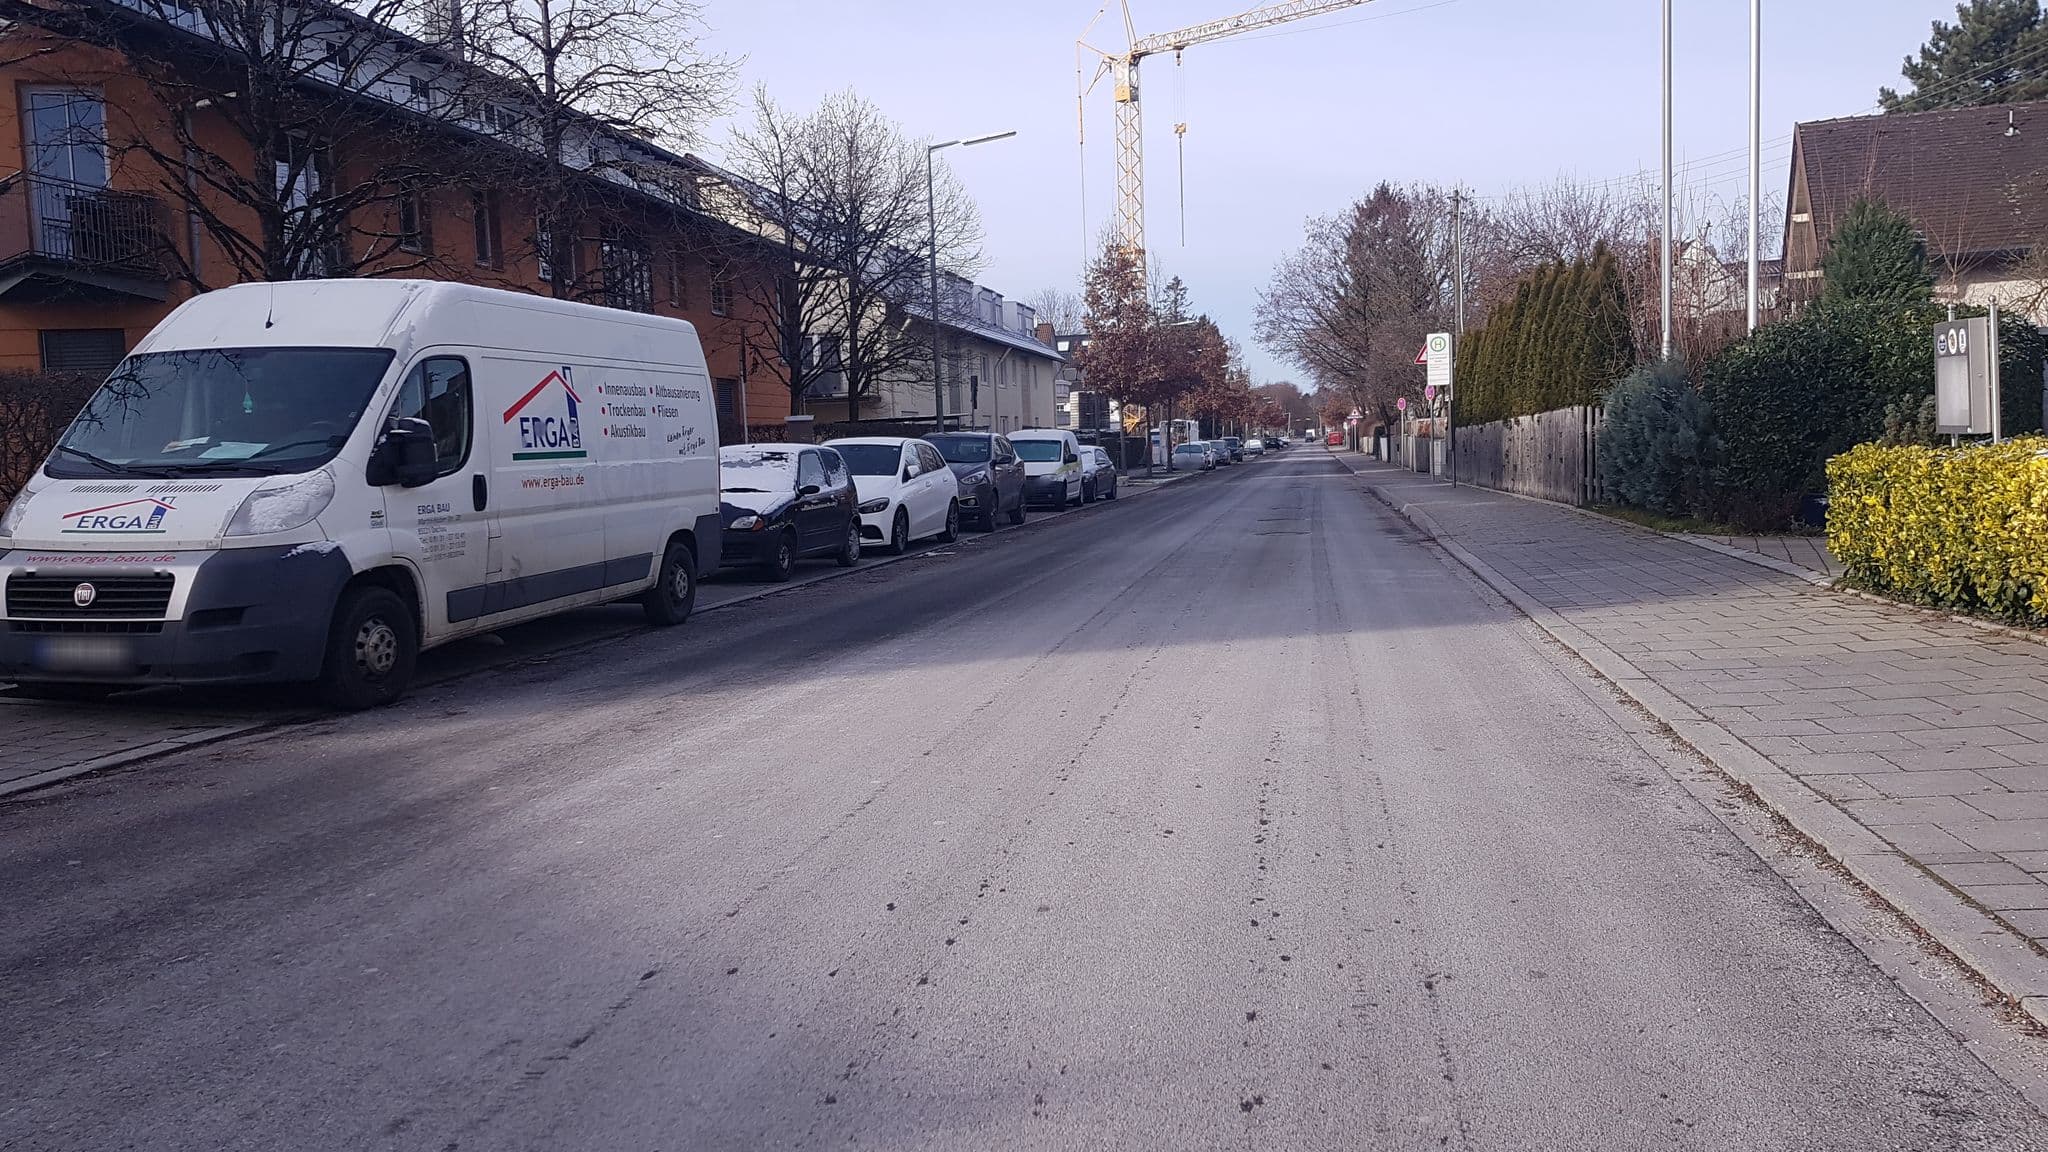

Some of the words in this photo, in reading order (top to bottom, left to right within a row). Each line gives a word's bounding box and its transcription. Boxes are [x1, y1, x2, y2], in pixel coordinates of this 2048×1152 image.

[604, 381, 646, 397] Innenausbau
[655, 384, 701, 402] Altbausanierung
[607, 402, 647, 417] Trockenbau
[657, 404, 679, 418] Fliesen
[520, 417, 570, 448] ERGA
[610, 424, 646, 438] Akustikbau
[522, 474, 584, 489] www.erga-bau.de
[417, 504, 435, 515] ERGA
[437, 503, 450, 513] BAU
[77, 516, 141, 529] ERGA
[26, 553, 176, 564] www.erga-bau.de
[77, 589, 91, 601] FIAT
